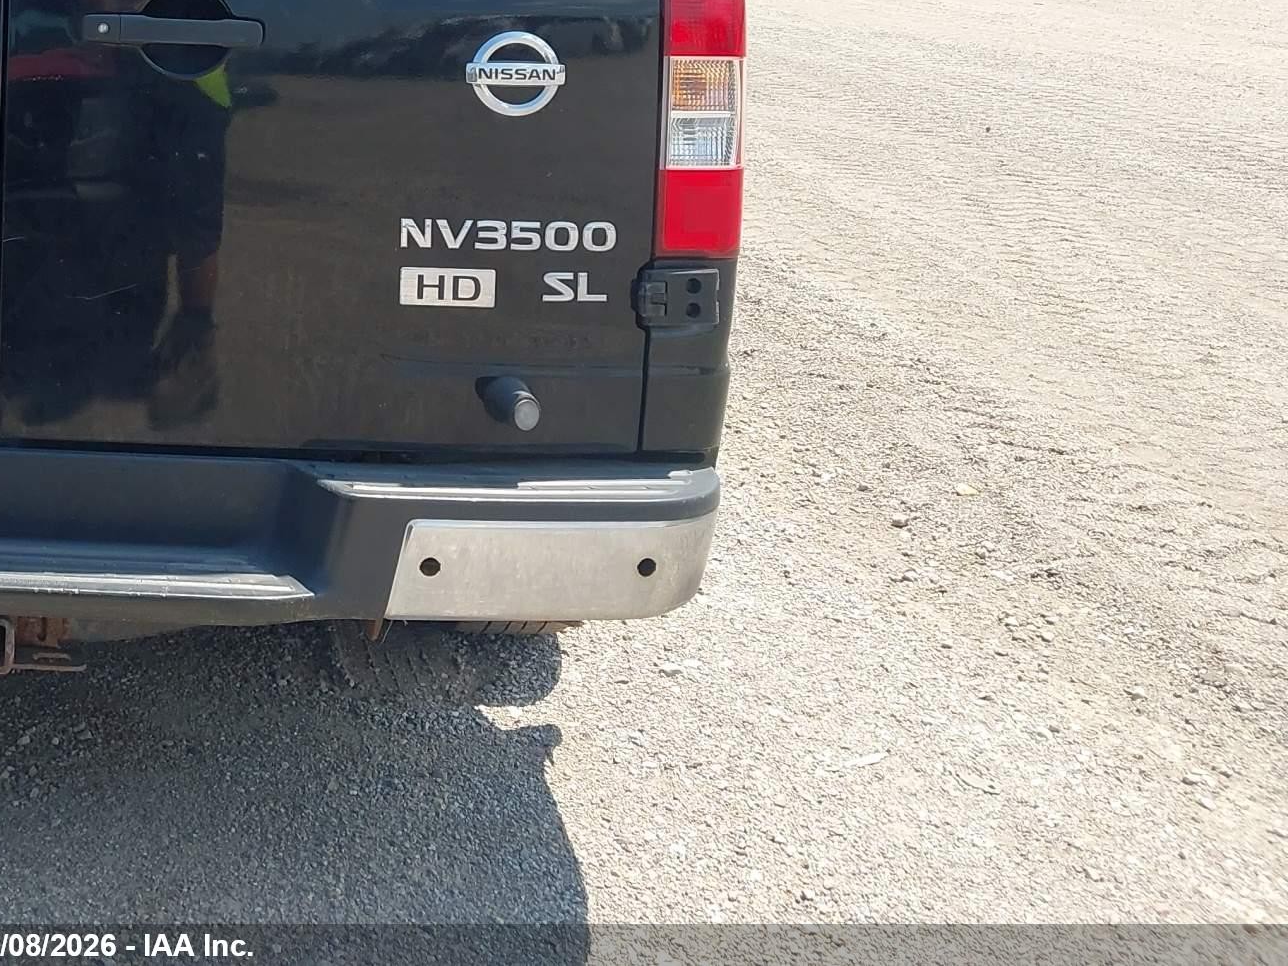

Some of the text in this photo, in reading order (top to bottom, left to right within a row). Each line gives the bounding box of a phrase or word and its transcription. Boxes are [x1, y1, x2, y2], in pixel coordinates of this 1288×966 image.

[478, 67, 556, 81] NISSAN
[400, 218, 617, 252] NV3500
[417, 273, 482, 301] HD
[542, 272, 608, 302] SL
